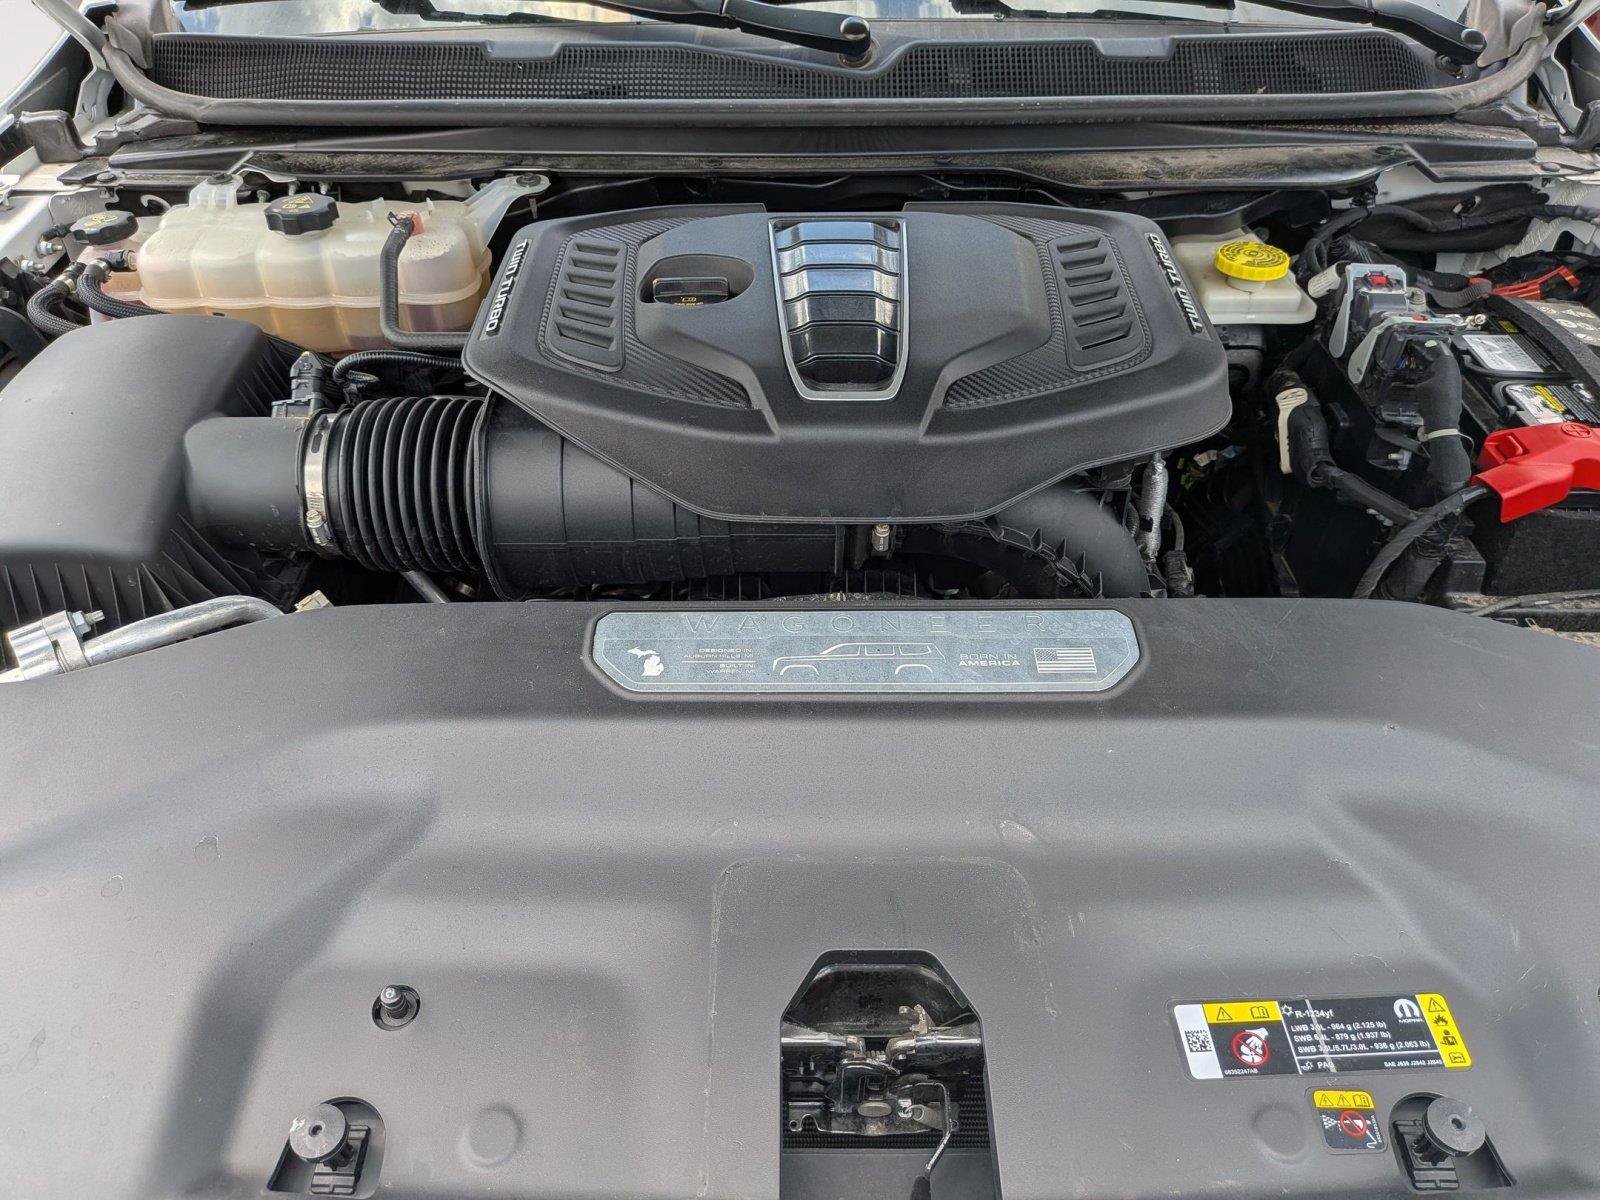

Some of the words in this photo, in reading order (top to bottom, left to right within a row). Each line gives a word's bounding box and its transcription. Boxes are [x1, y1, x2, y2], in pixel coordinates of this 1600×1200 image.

[505, 239, 529, 278] TWIN
[1148, 233, 1181, 286] TURBO
[485, 276, 515, 335] TURBO
[1176, 287, 1203, 333] TWIN
[684, 613, 1046, 633] WAGONEER
[1290, 1024, 1309, 1032] LWB
[1352, 1021, 1375, 1030] (2.125
[1376, 1020, 1387, 1028] lb)
[1293, 1034, 1312, 1042] SWB
[1357, 1031, 1378, 1040] (1.937
[1380, 1031, 1391, 1039] lb)
[1297, 1045, 1317, 1053] SWB
[1420, 1040, 1430, 1048] lb)
